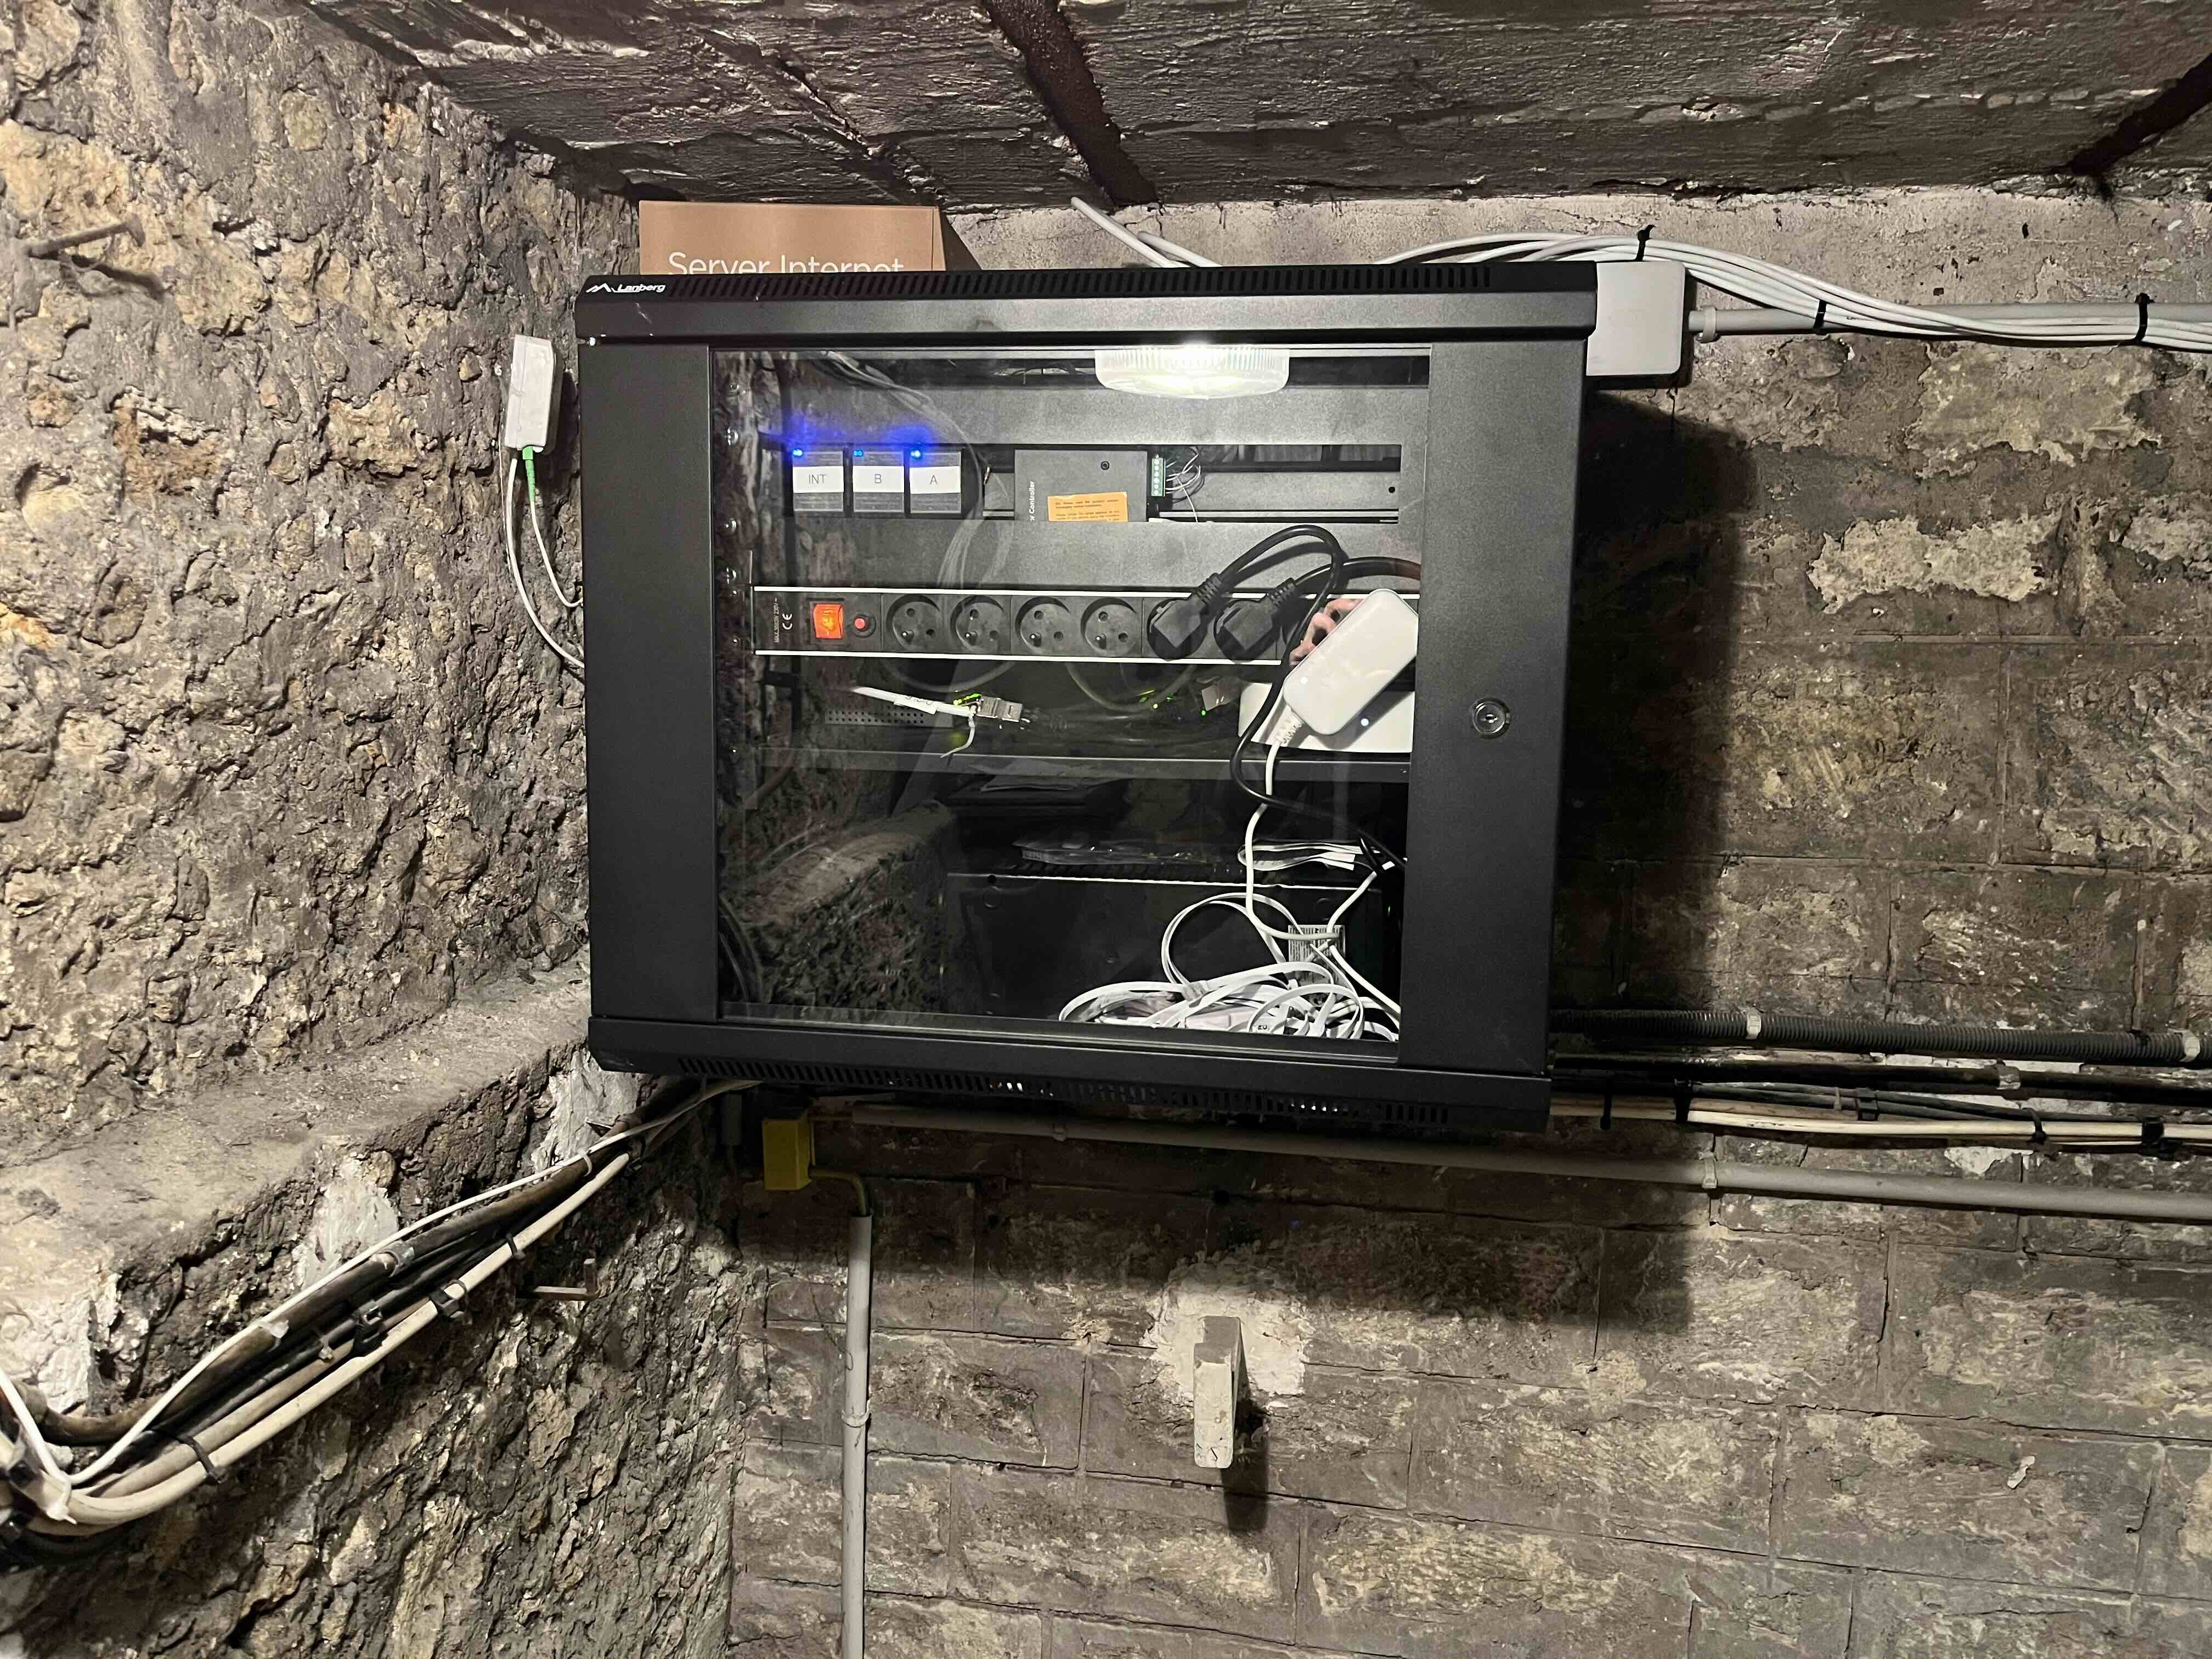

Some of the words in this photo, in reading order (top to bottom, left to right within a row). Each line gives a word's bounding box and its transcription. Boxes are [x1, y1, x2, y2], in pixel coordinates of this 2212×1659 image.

[669, 251, 770, 274] Server
[617, 283, 666, 292] Lanberg
[808, 474, 826, 484] INT
[874, 473, 882, 484] B
[930, 475, 938, 484] A
